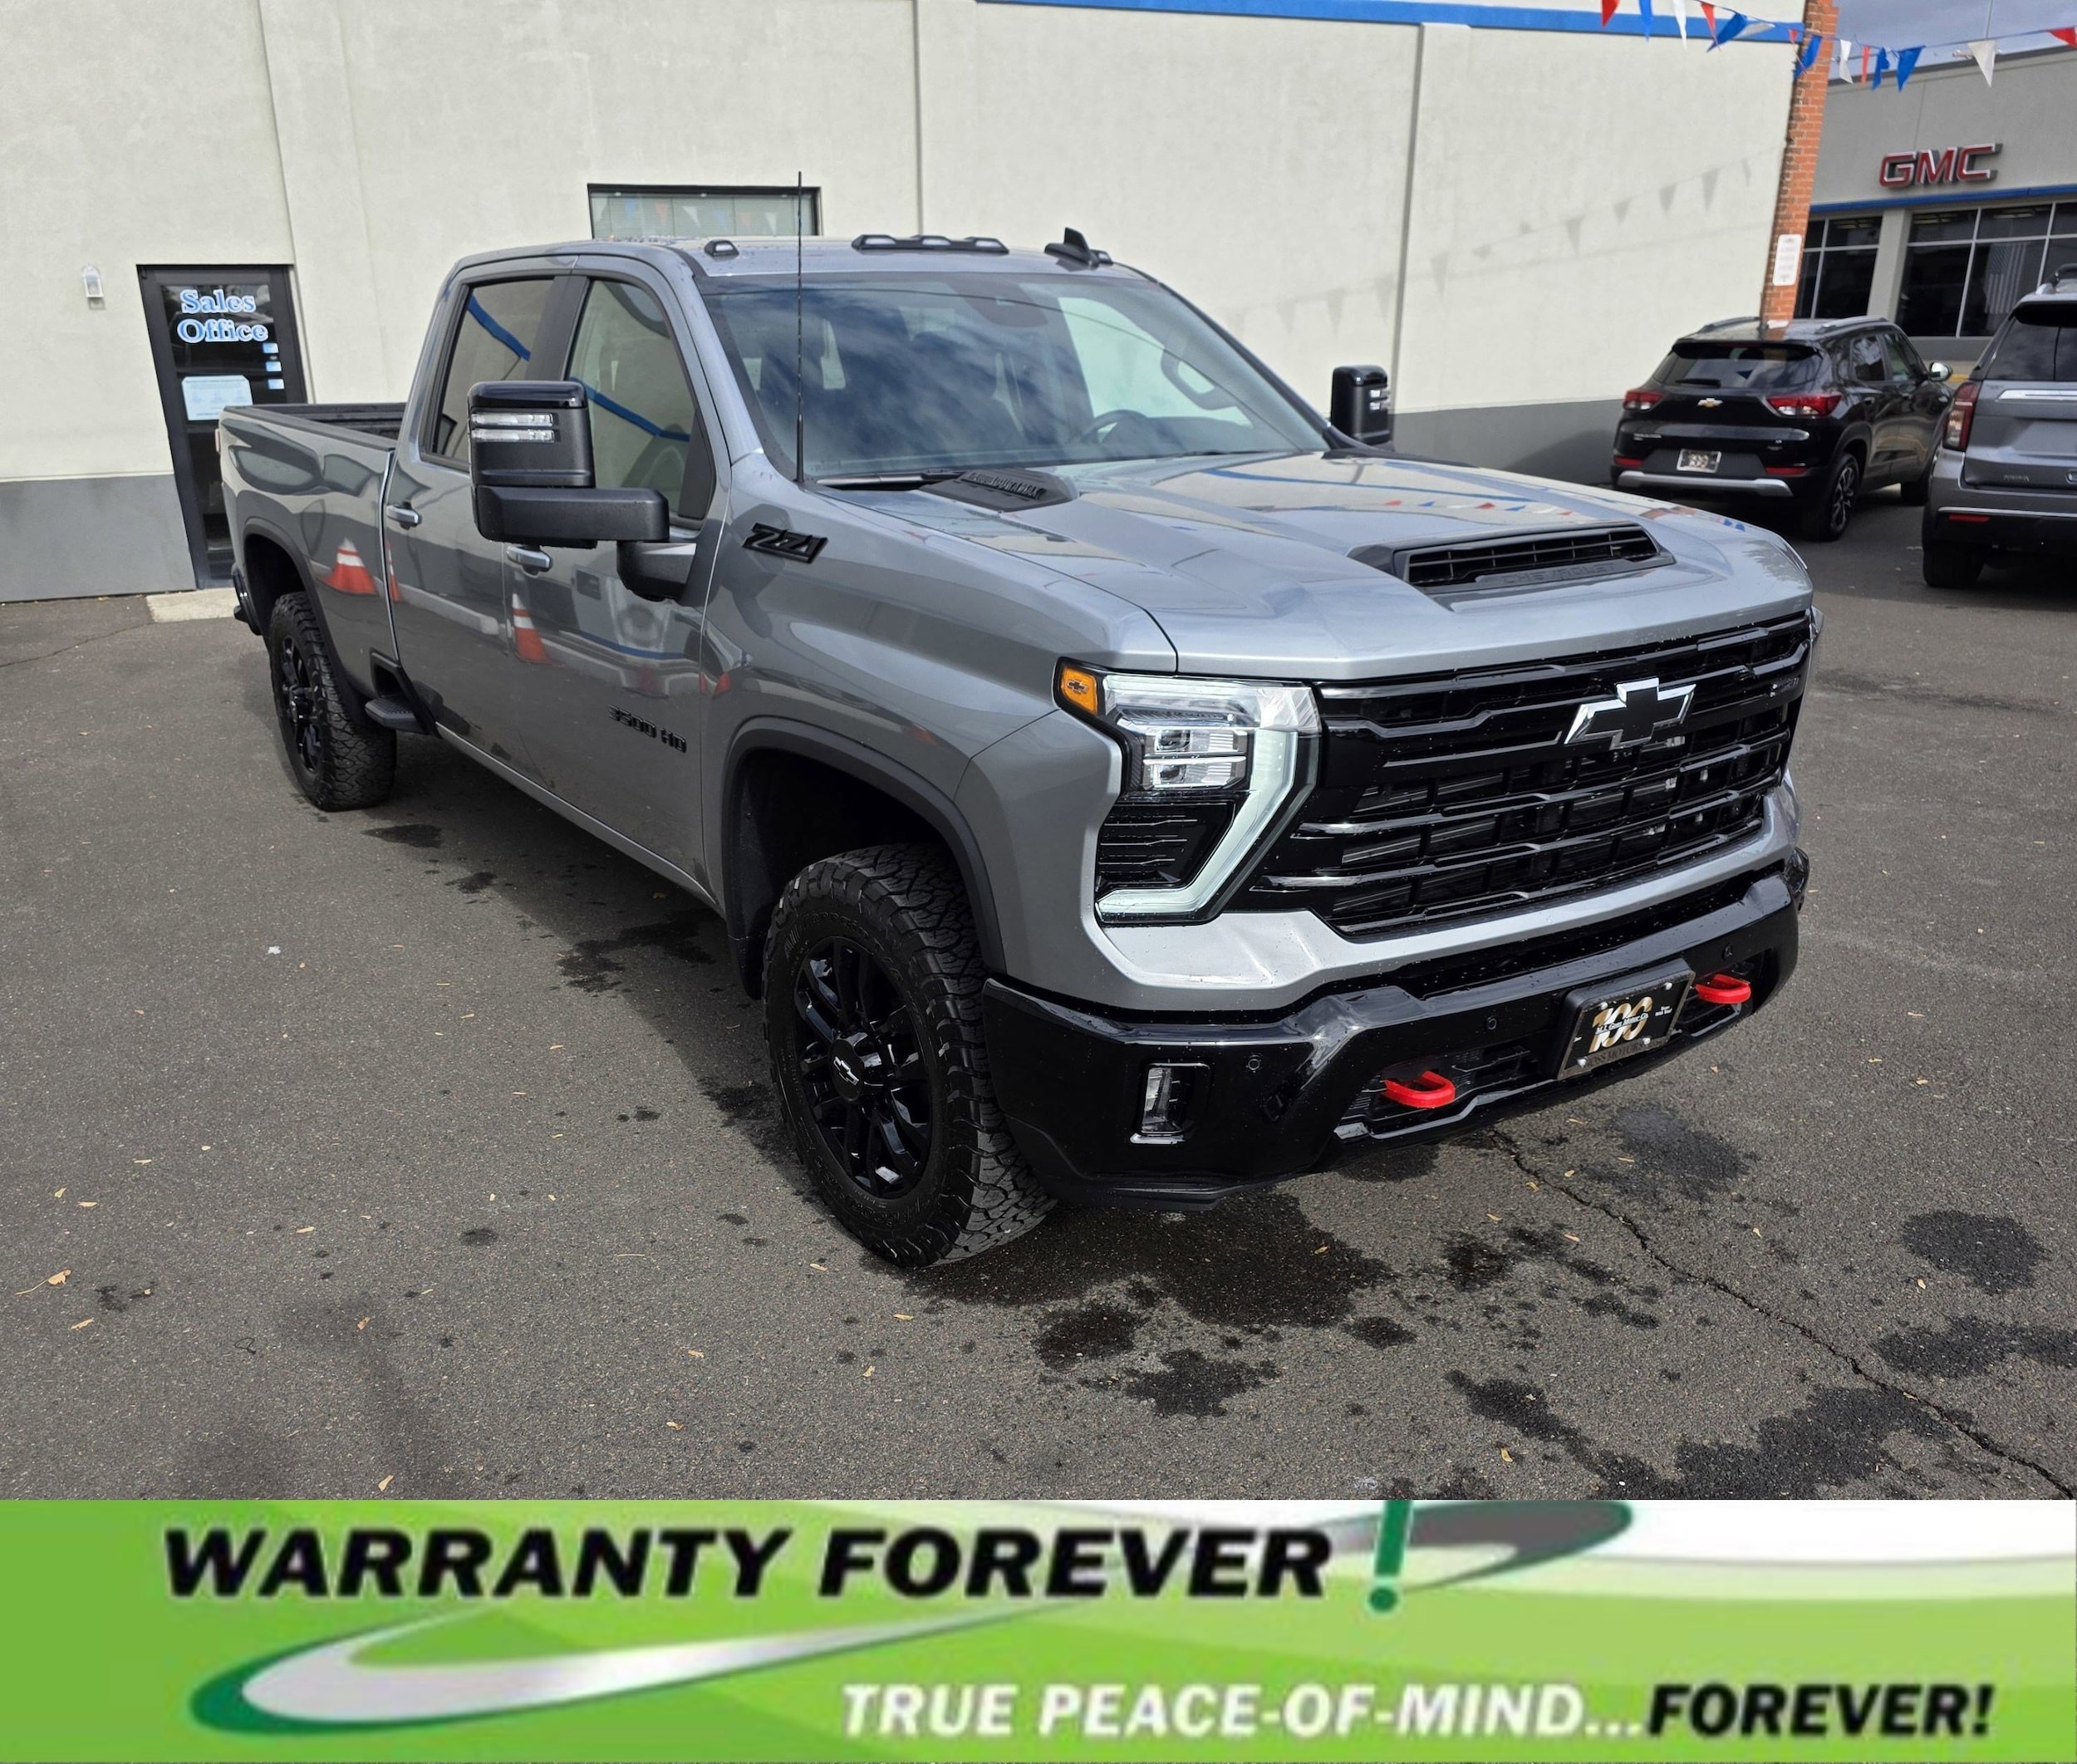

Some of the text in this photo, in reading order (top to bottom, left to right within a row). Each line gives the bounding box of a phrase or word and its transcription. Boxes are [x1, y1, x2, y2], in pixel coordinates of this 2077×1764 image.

[1879, 143, 2001, 188] GMC
[179, 289, 257, 314] Sales
[177, 319, 268, 343] Office
[743, 522, 827, 564] Z71
[660, 727, 687, 753] HD
